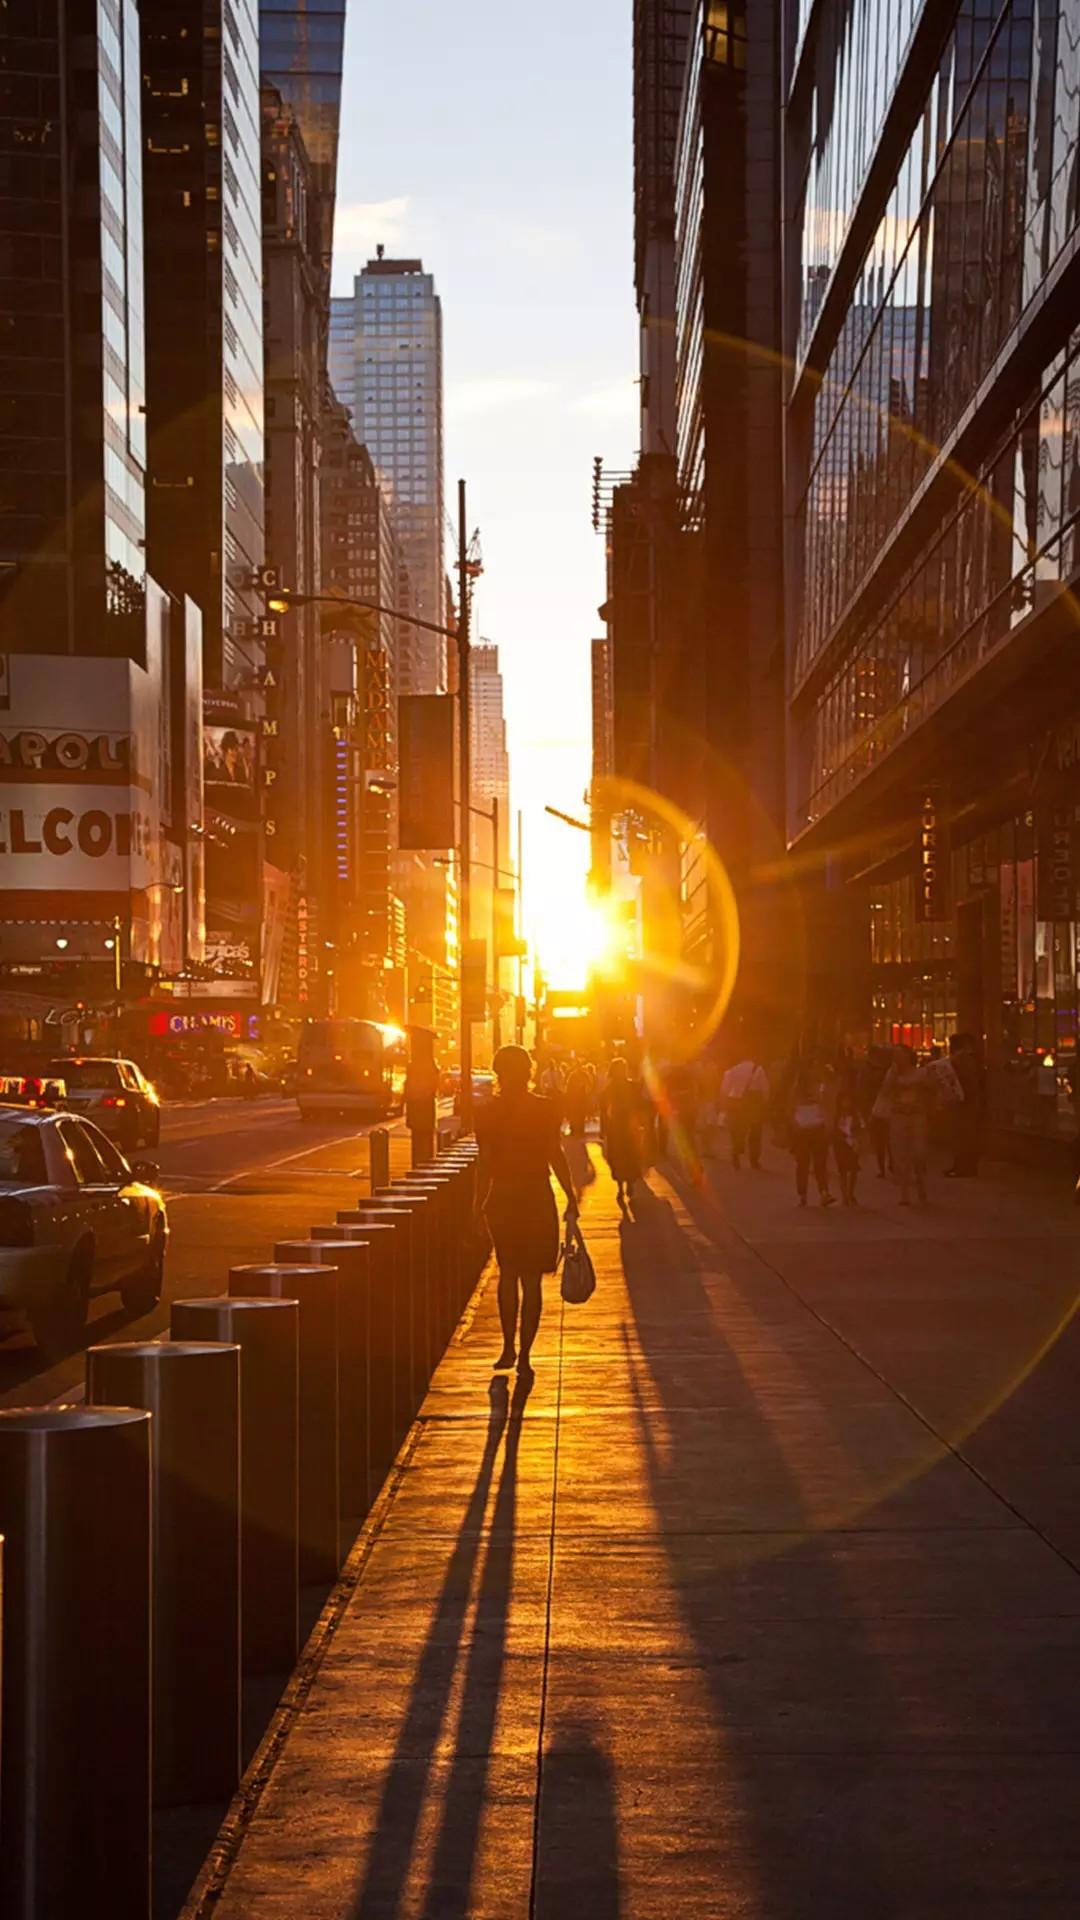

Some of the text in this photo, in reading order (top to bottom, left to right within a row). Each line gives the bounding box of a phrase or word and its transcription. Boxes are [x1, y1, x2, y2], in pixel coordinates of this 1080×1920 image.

[262, 570, 278, 835] CHAMPS
[366, 651, 386, 769] MADAME
[922, 797, 937, 917] AUREOLE
[298, 897, 309, 1001] AMSTERDAM
[170, 1015, 236, 1032] CHAMPS
